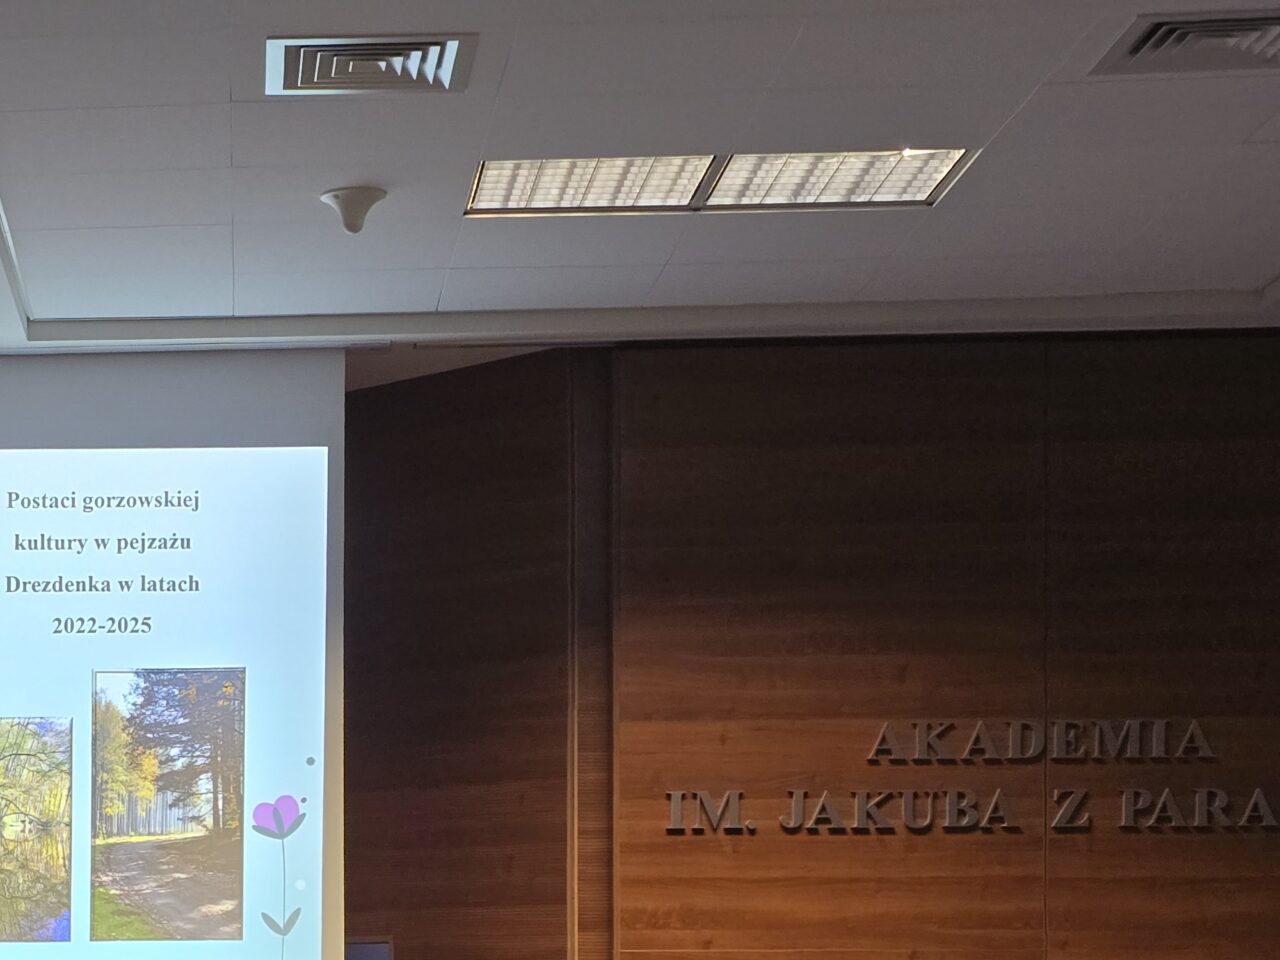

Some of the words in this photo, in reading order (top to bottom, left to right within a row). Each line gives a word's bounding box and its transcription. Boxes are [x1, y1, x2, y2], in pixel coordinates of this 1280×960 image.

[7, 491, 77, 509] Postaci
[82, 490, 200, 513] gorzowskiej
[14, 533, 88, 554] kultury
[95, 539, 110, 550] w
[116, 532, 192, 554] pejzażu
[5, 575, 111, 593] Drezdenka
[118, 580, 133, 592] w
[140, 574, 200, 592] latach
[52, 616, 152, 634] 2022-2025
[867, 719, 1217, 764] AKADEMIA
[666, 790, 757, 834] IM.
[778, 788, 1022, 835] JAKUBA
[1051, 788, 1091, 831] Z
[1119, 787, 1279, 831] PARA
